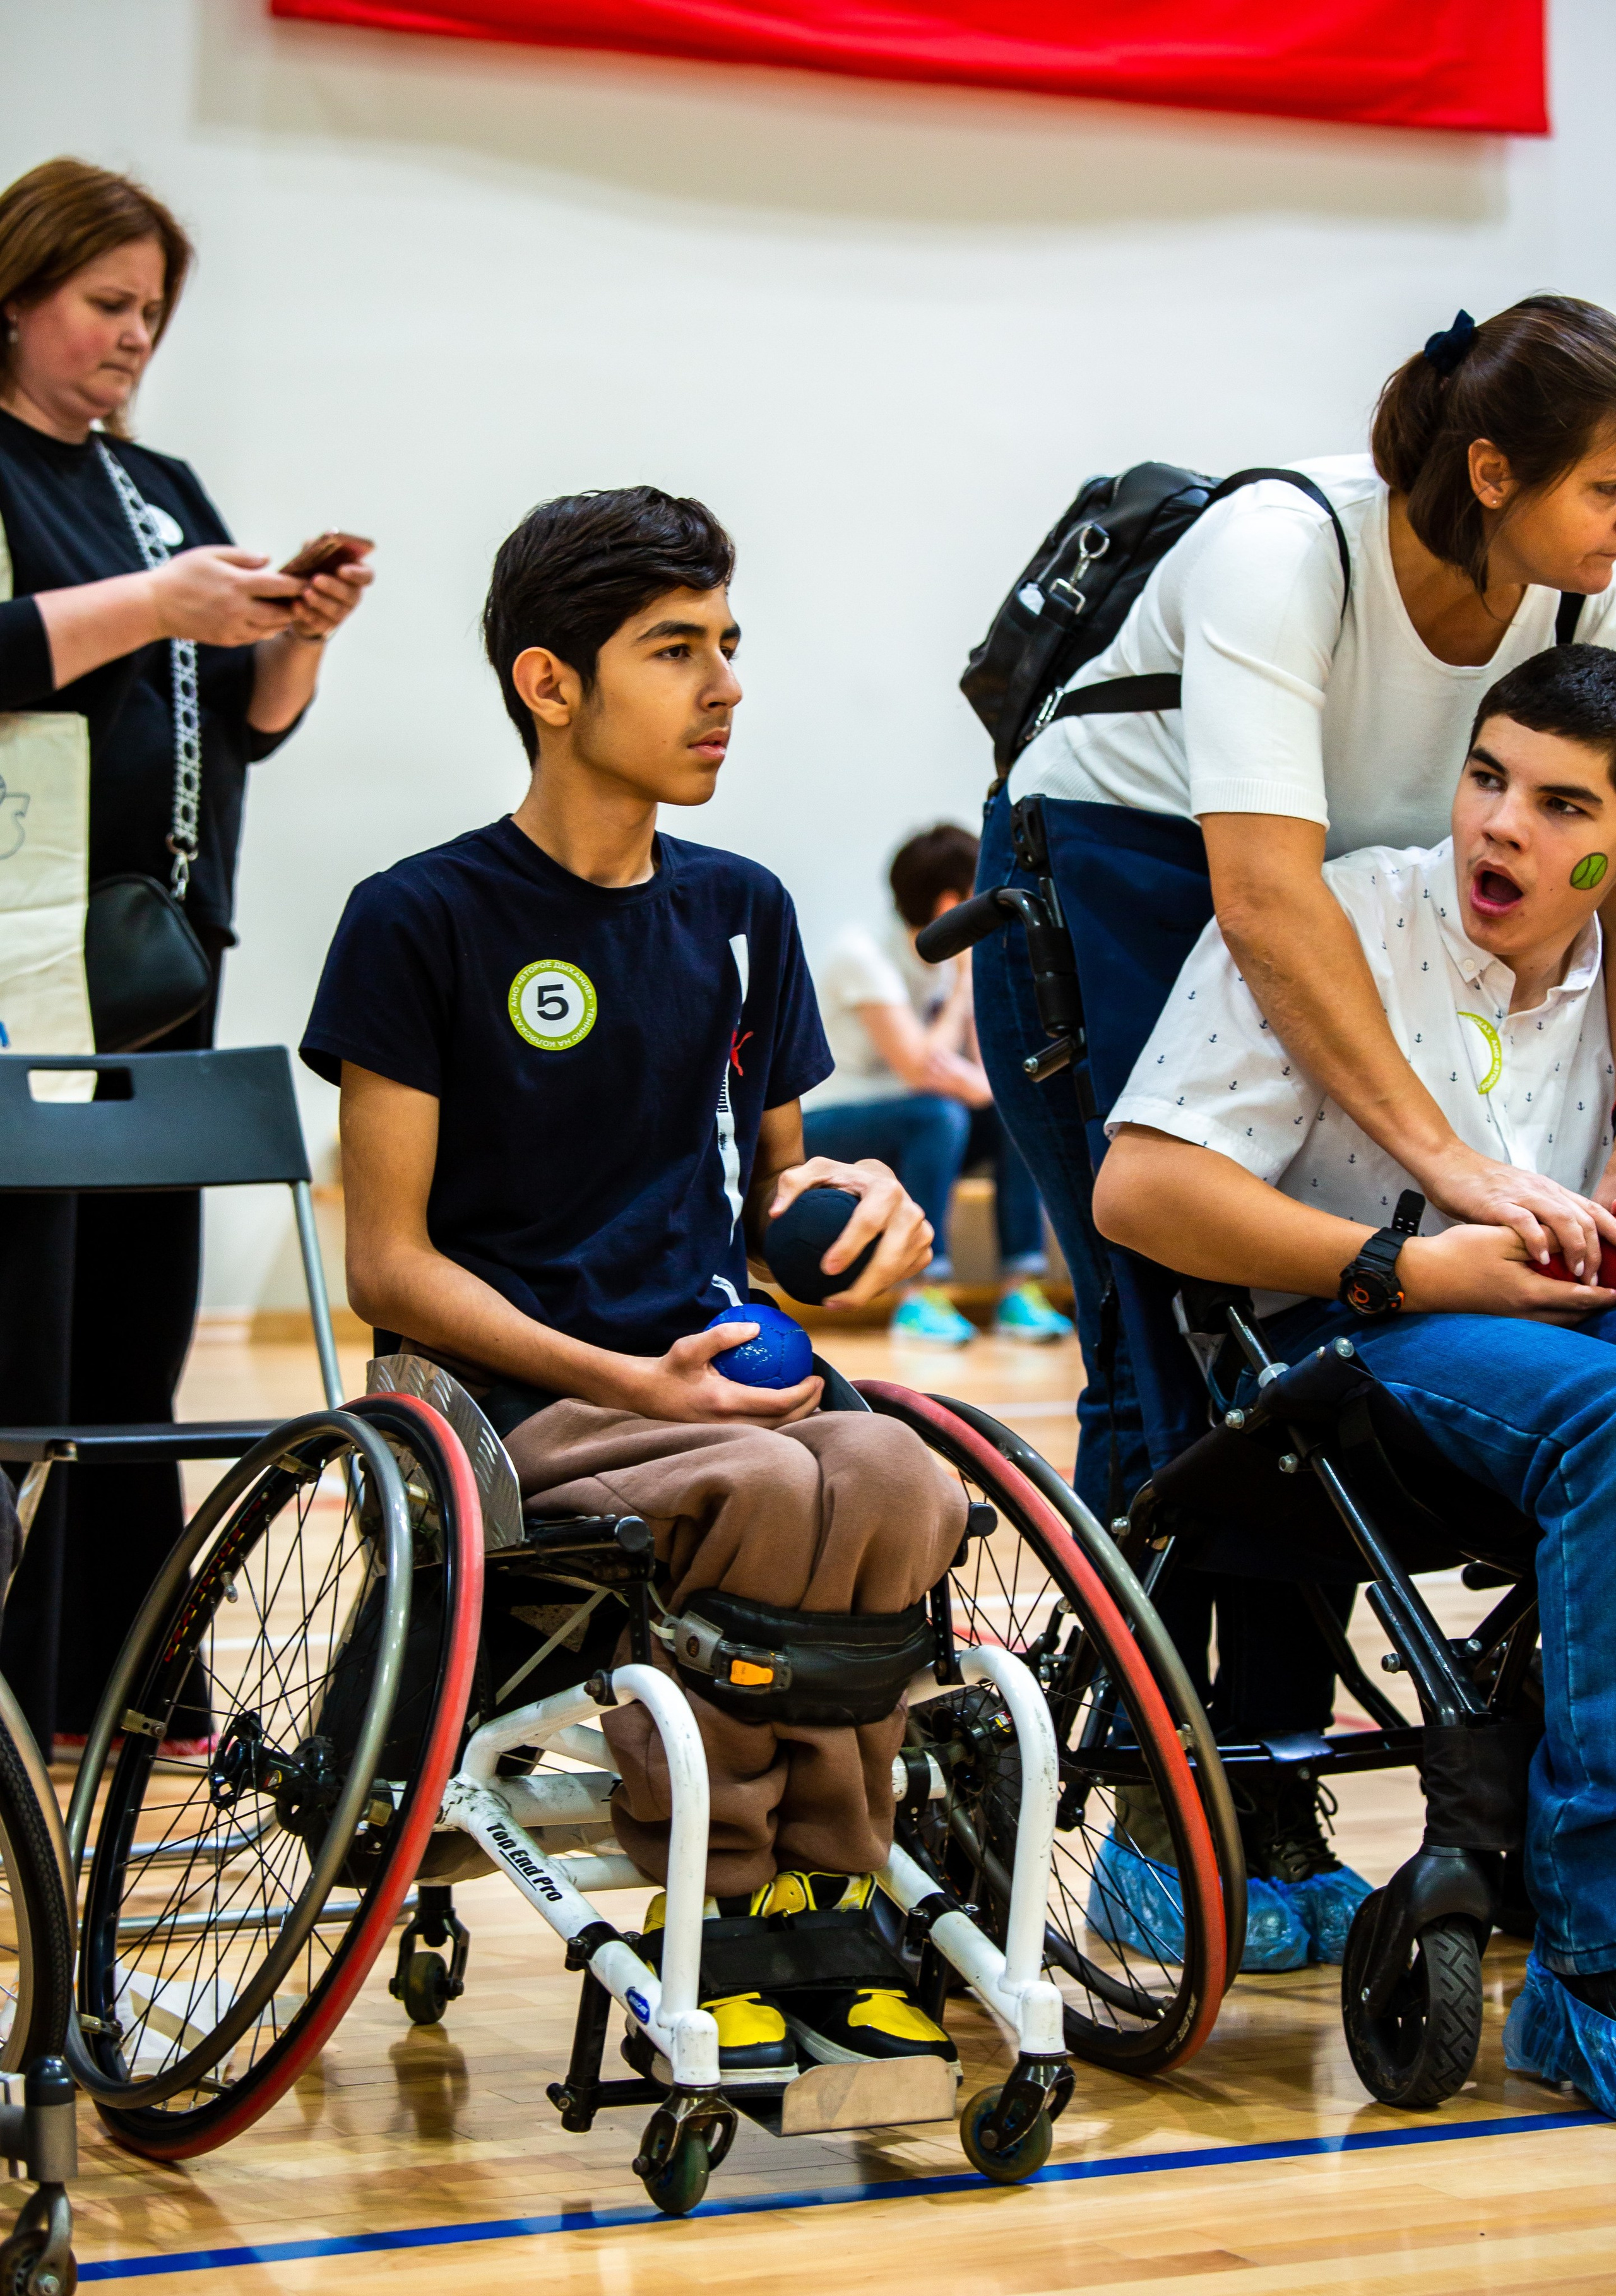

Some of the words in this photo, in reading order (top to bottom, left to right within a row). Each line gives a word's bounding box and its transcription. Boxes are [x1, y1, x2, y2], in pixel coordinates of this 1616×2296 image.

[511, 987, 520, 1007] АНО
[537, 984, 569, 1021] 5
[513, 1013, 556, 1047] КОЛЯСКАХ
[572, 1008, 595, 1041] ТЕННИС
[557, 1037, 571, 1047] НА
[486, 1823, 516, 1850] Top
[508, 1850, 545, 1876] End
[532, 1877, 562, 1901] Pro
